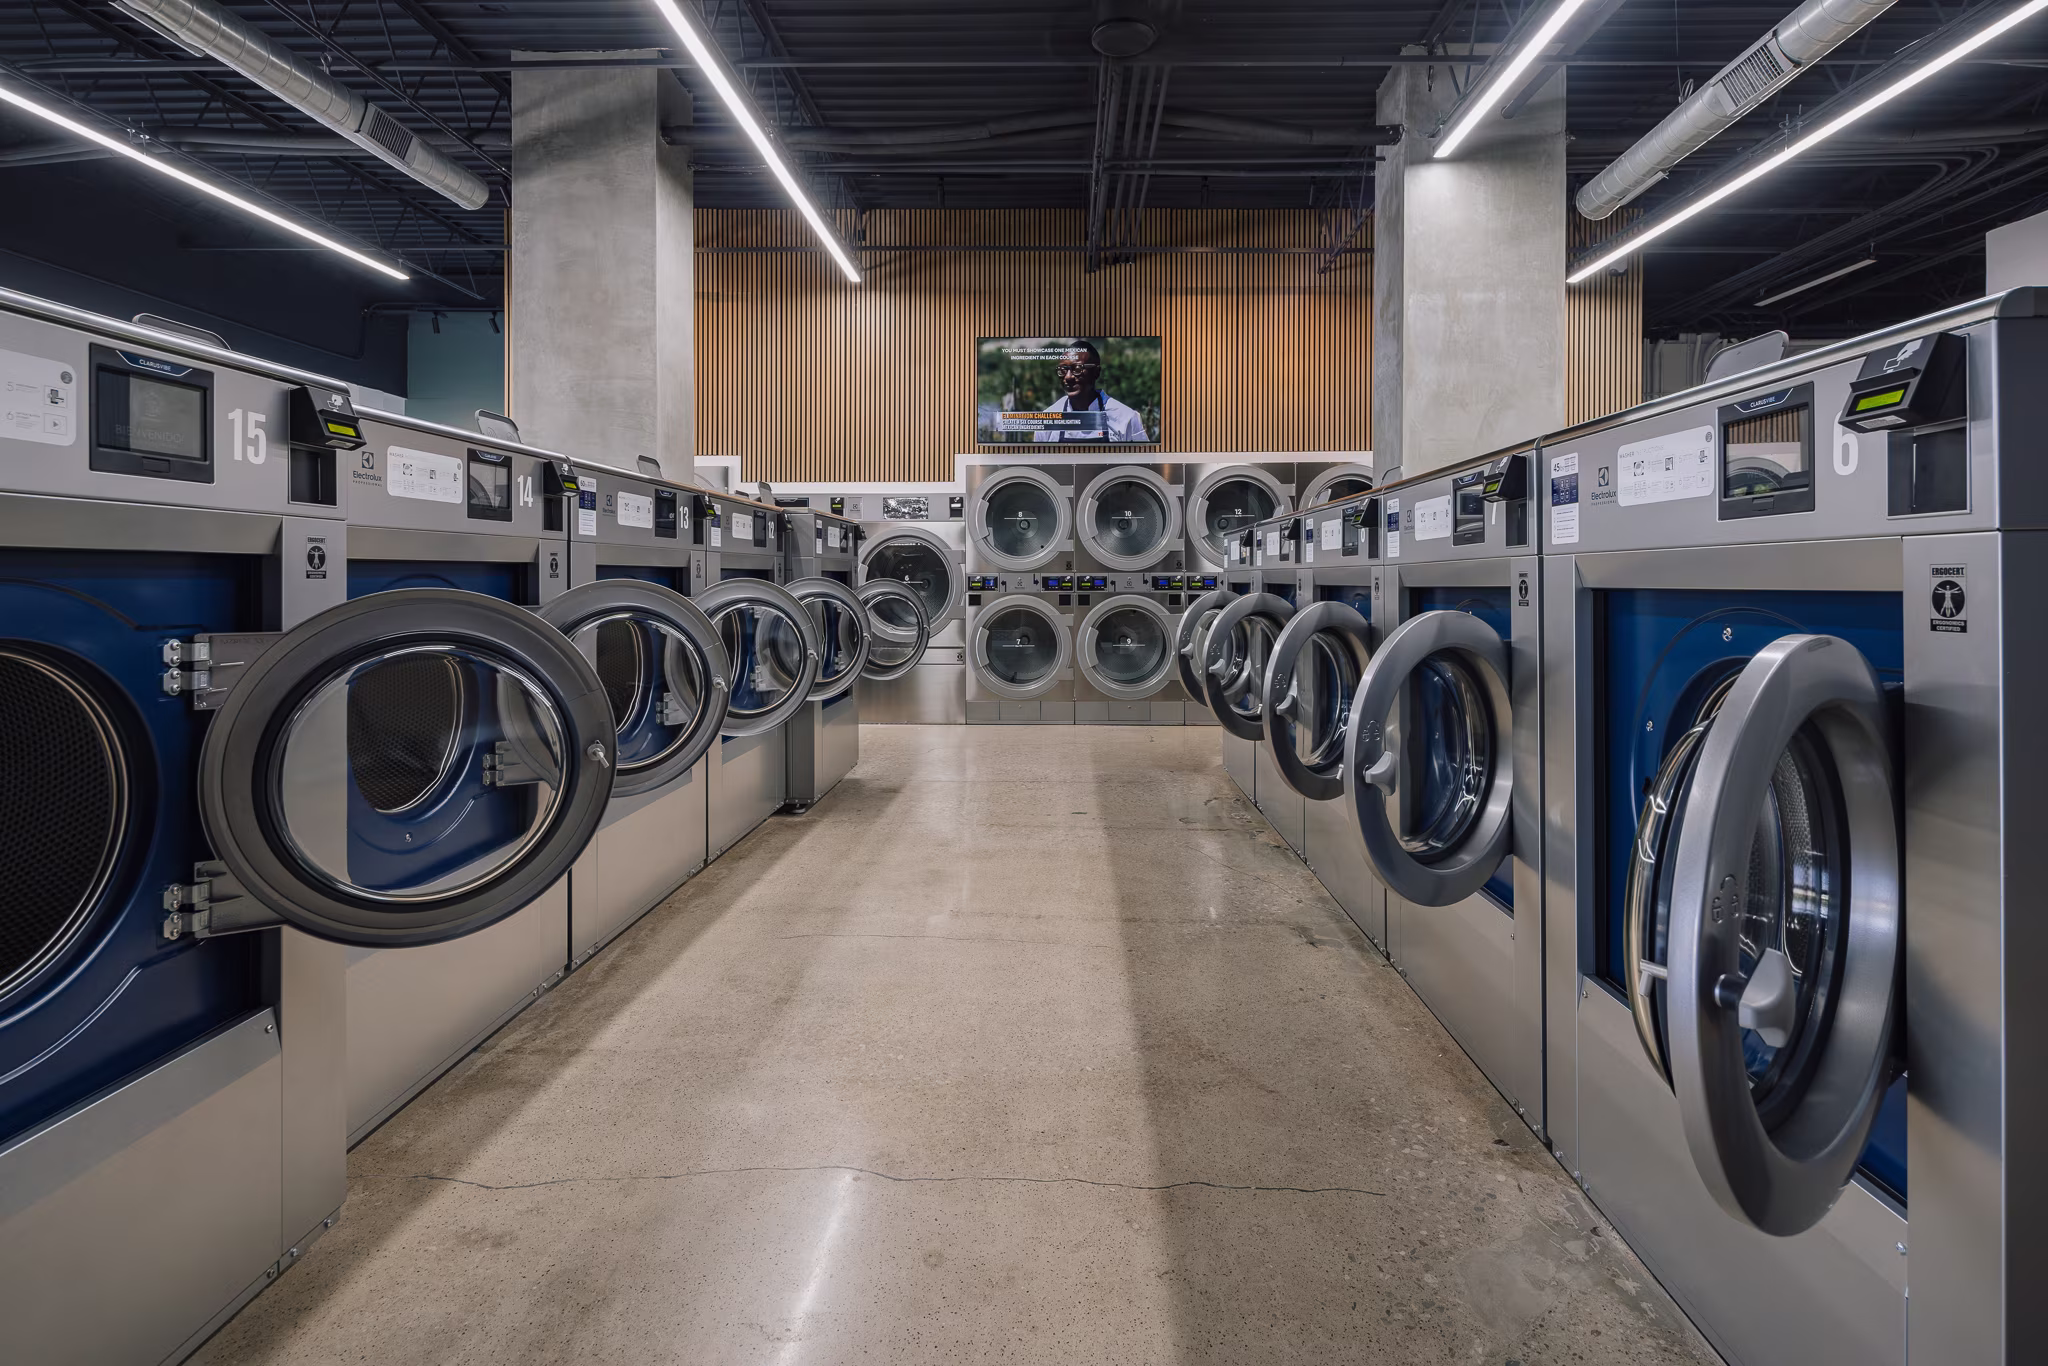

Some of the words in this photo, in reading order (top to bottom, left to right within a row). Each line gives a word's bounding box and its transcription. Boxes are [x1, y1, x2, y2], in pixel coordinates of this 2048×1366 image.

[139, 358, 171, 372] CLARUSVIBE
[1750, 396, 1775, 408] CLARUSVIBE
[228, 408, 267, 465] 15
[352, 470, 383, 482] Electrolux
[517, 475, 533, 507] 14
[1591, 490, 1617, 501] Electrolux
[680, 505, 689, 529] 13
[768, 520, 775, 539] 12
[1932, 567, 1965, 576] ERGOCERT
[1126, 637, 1132, 645] 9
